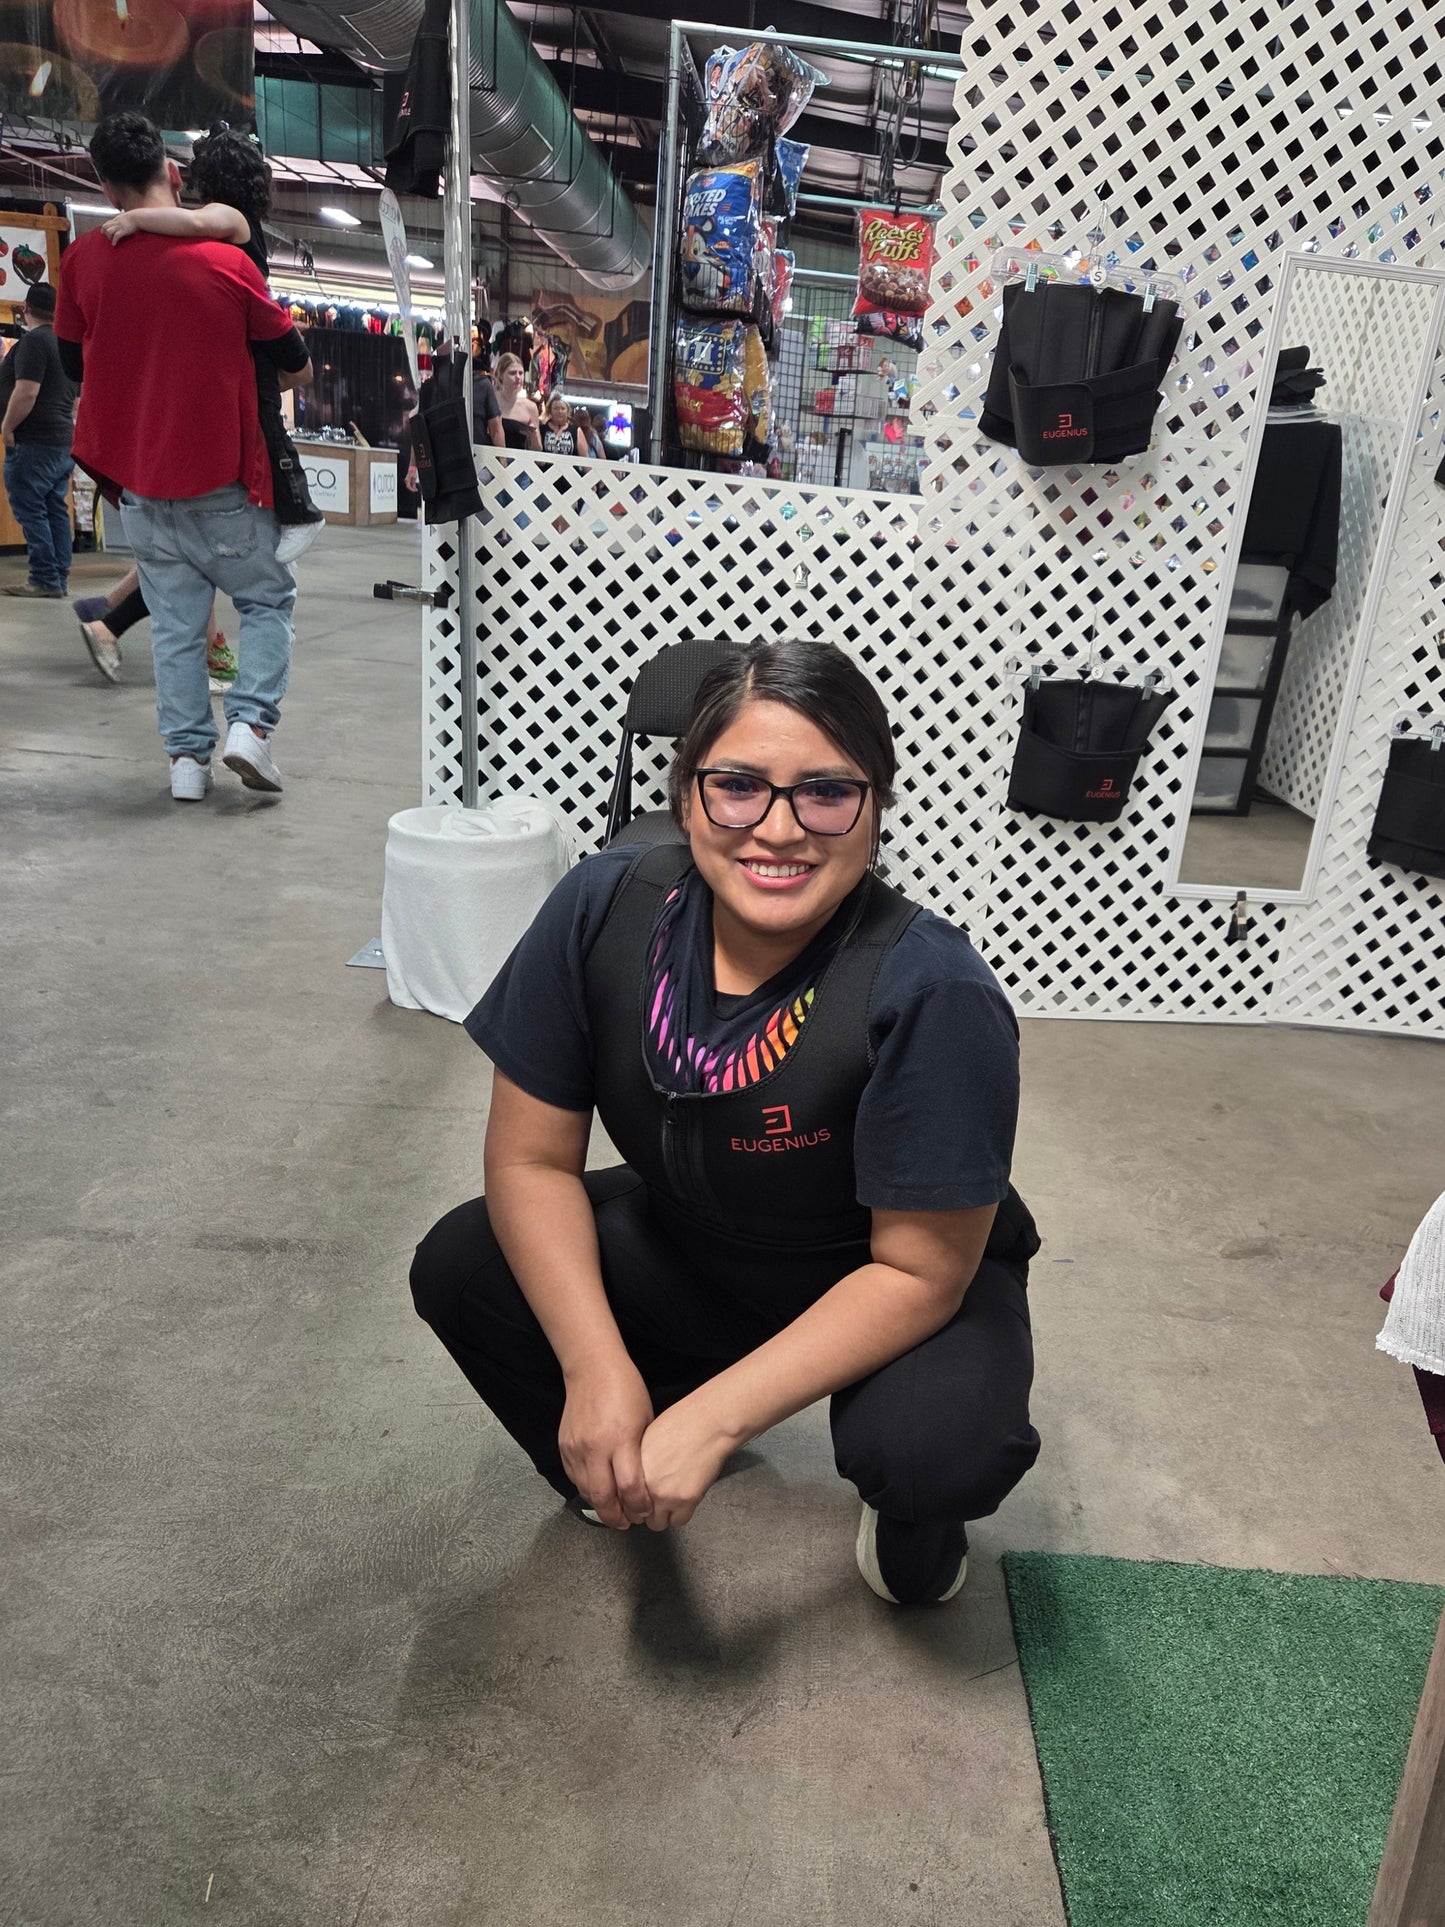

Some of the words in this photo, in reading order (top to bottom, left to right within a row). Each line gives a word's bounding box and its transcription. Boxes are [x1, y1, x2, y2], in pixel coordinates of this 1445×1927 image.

[868, 240, 921, 261] Puffs
[1042, 428, 1088, 439] EUGENIUS
[1086, 790, 1120, 799] EUGENIUS
[731, 1128, 831, 1152] EUGENIUS
